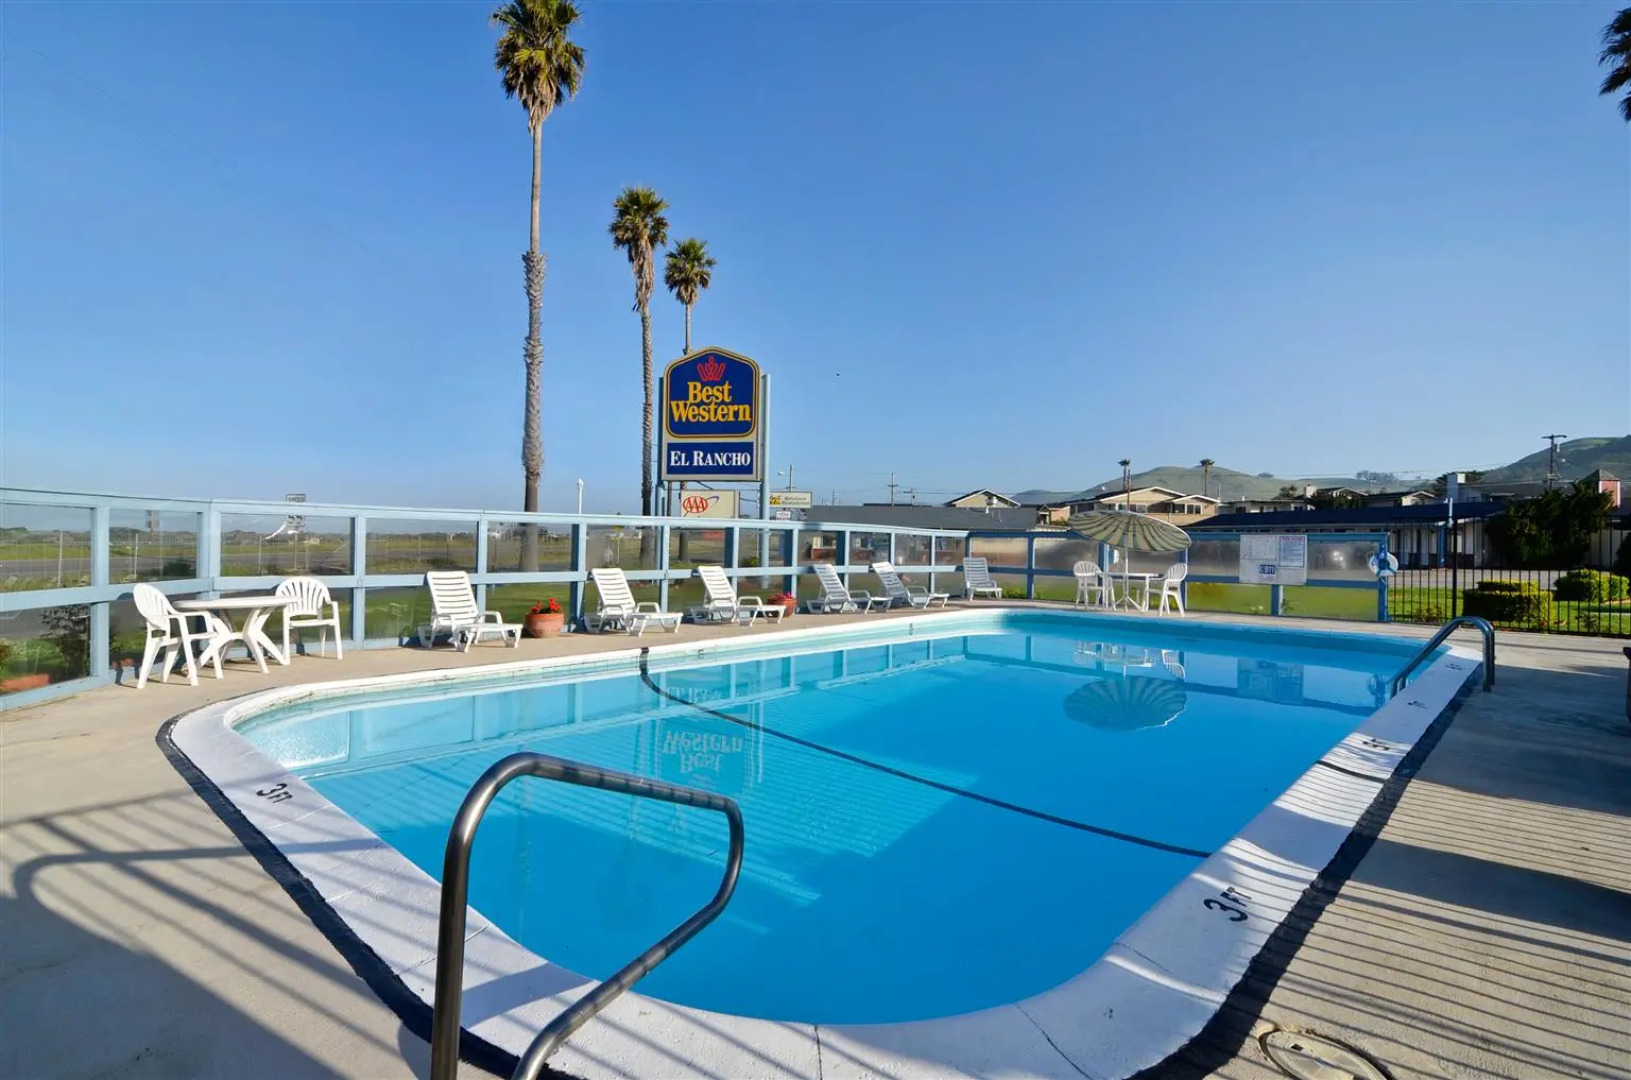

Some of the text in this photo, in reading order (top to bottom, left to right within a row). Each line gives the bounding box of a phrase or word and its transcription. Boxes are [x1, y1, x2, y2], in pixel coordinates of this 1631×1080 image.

[687, 381, 732, 403] Best
[670, 400, 752, 423] Western
[670, 450, 751, 467] EL RANCHO
[684, 496, 707, 513] AAA
